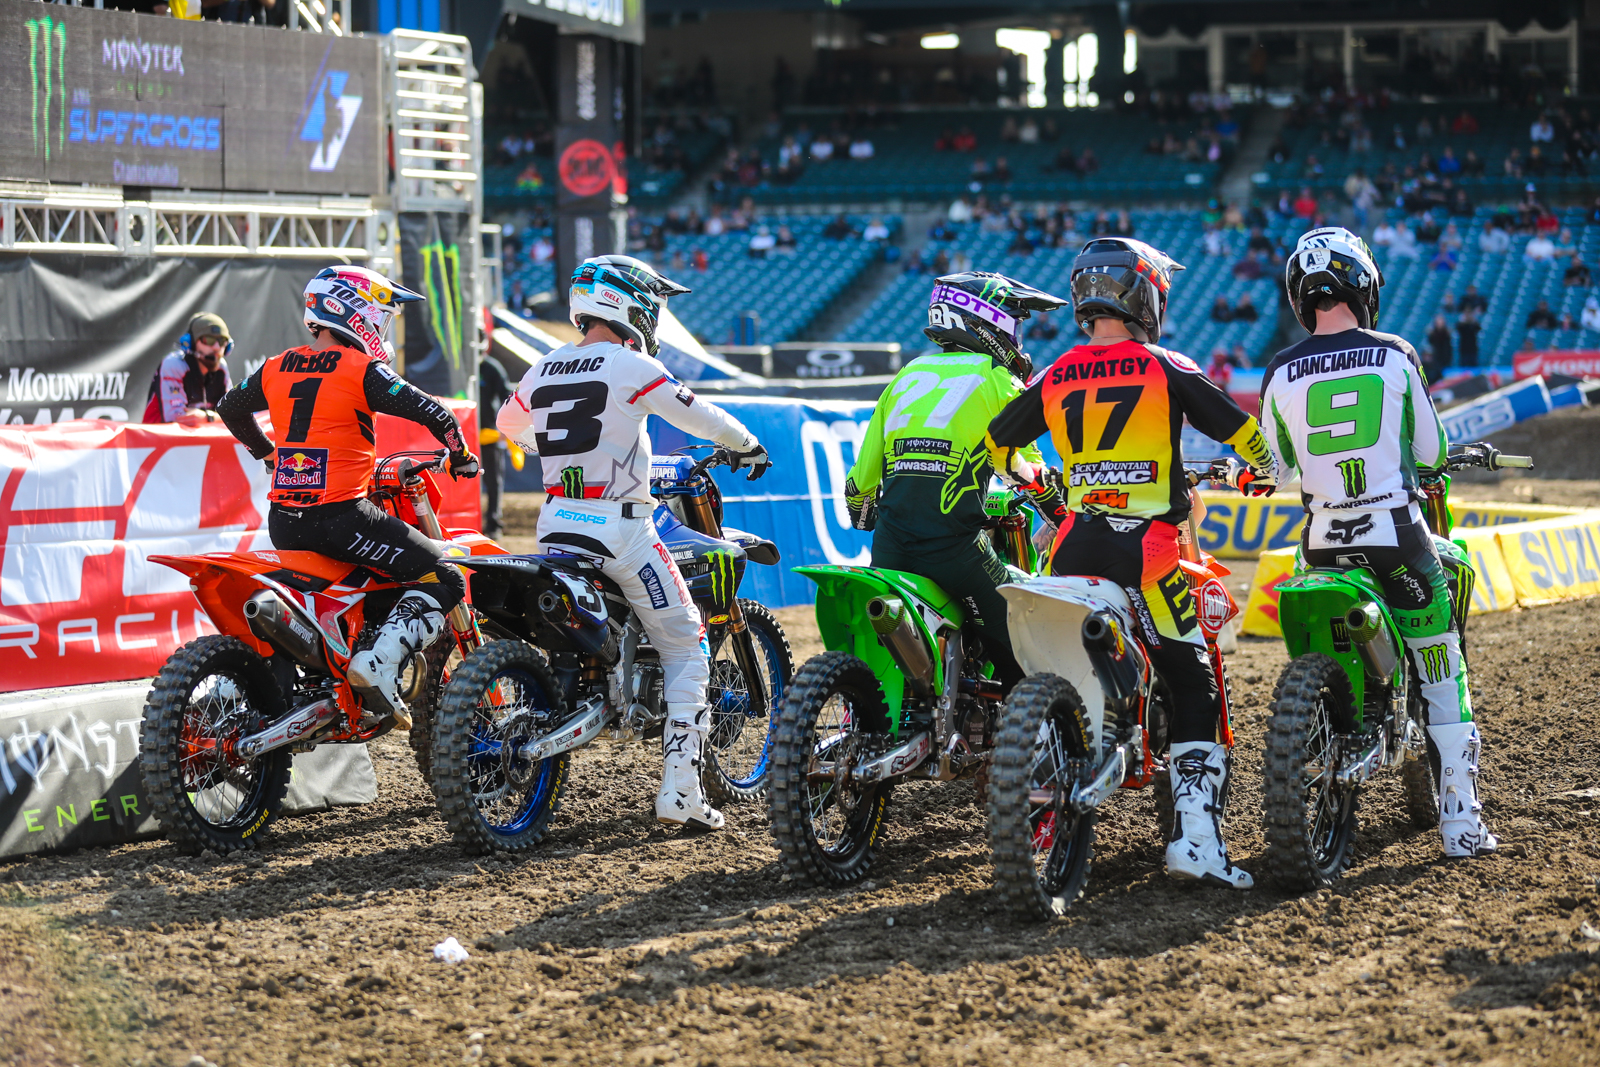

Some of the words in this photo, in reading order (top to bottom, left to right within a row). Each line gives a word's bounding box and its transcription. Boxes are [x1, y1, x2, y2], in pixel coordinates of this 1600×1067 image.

[102, 36, 184, 76] MONSTER
[69, 108, 221, 150] SUPERCROSS
[325, 299, 341, 313] BELL
[603, 291, 620, 303] BELL
[348, 312, 376, 344] Red
[368, 335, 388, 361] Bull
[279, 351, 342, 374] WEBB
[540, 356, 605, 378] TOMAC
[1052, 357, 1151, 385] SAVATGY
[1287, 347, 1388, 383] CIANCIARULO
[285, 377, 323, 443] 1
[530, 381, 609, 457] 3
[884, 371, 987, 438] 21
[1061, 385, 1145, 454] 17
[1306, 373, 1384, 456] 9
[906, 439, 949, 449] MONSTER
[278, 472, 299, 485] Red
[300, 472, 321, 485] Bull
[278, 491, 322, 504] KTM
[1082, 489, 1129, 509] KTM
[554, 508, 607, 525] ASTARS
[292, 573, 312, 582] WEBB
[487, 559, 530, 567] DUNLOP
[647, 576, 666, 607] YAMAHA
[1165, 568, 1196, 622] FLY
[1400, 614, 1434, 627] FOX
[1074, 709, 1089, 751] DUNLOP
[549, 760, 565, 810] DUNLOP
[242, 808, 269, 840] DUNLOP
[869, 797, 885, 847] DUNLOP
